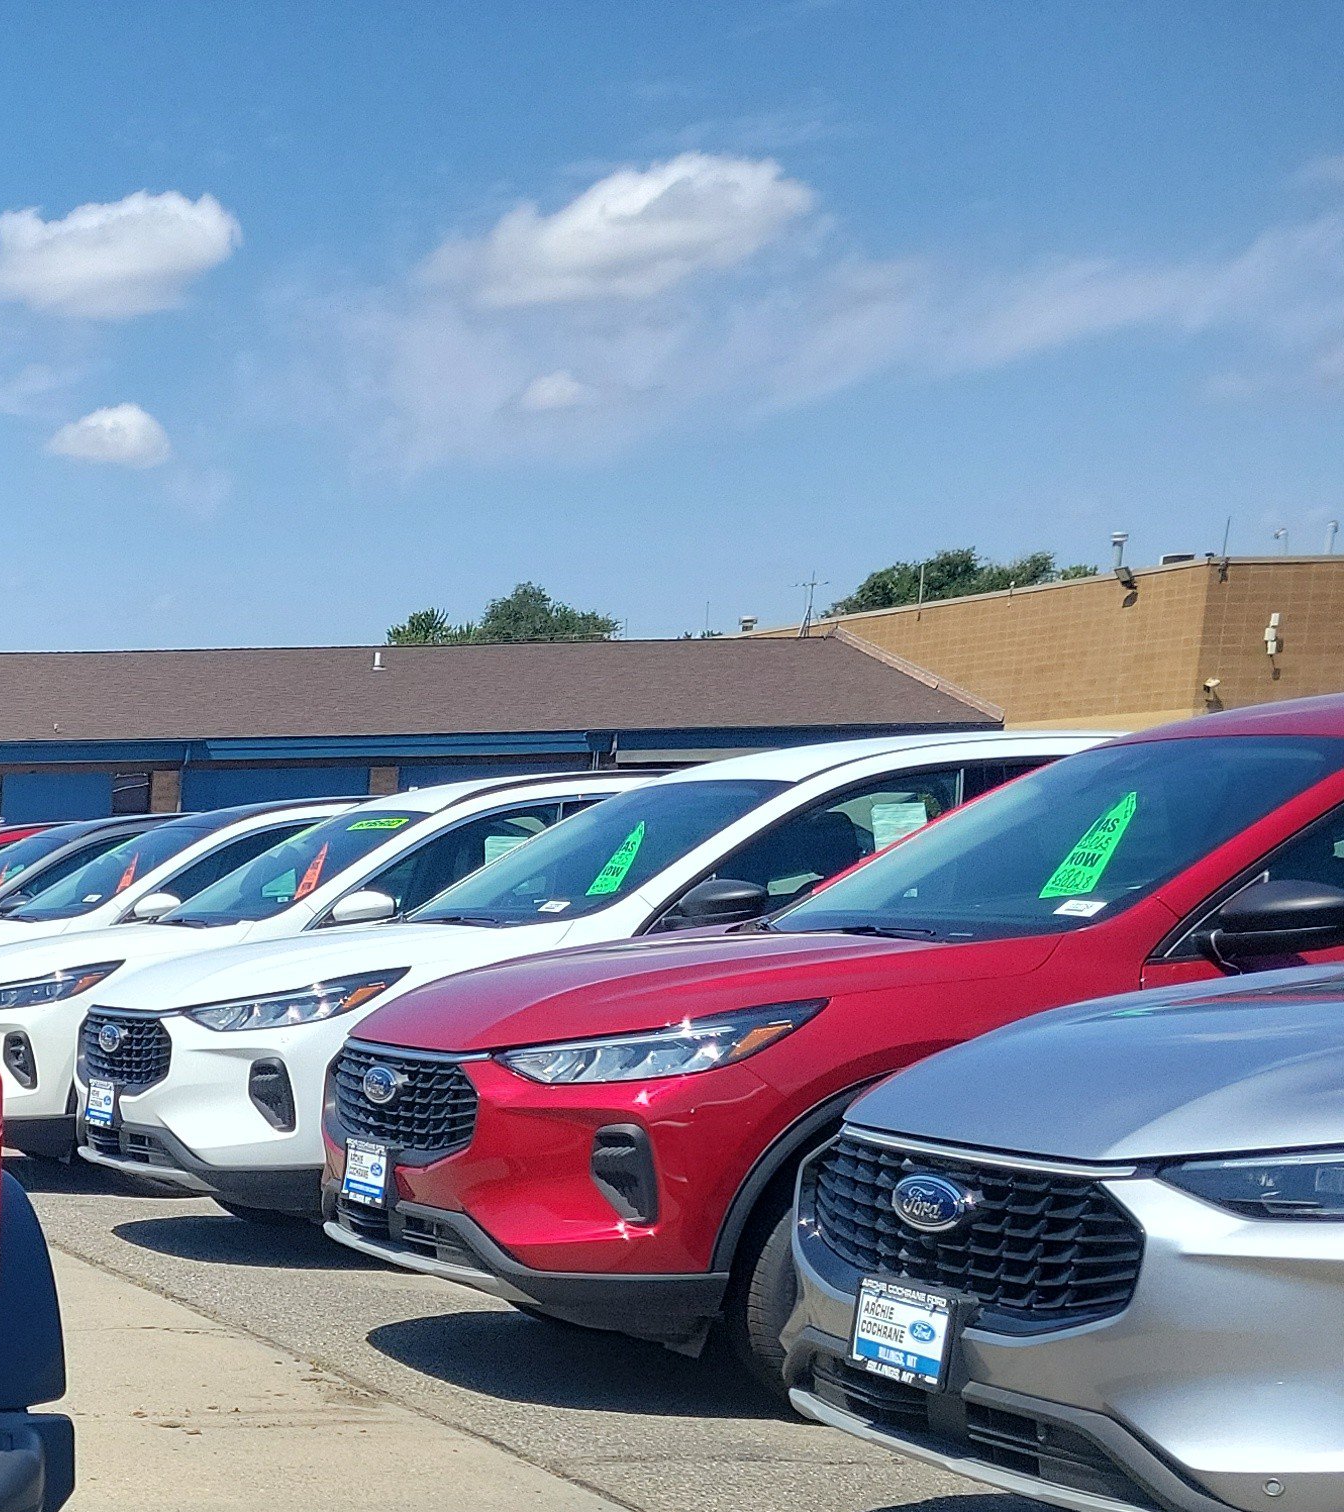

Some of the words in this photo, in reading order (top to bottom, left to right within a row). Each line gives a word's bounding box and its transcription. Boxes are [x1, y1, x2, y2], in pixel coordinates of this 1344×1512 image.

[902, 1185, 944, 1219] Ford
[863, 1300, 895, 1320] ARCHIE
[860, 1319, 906, 1344] COCHRANE
